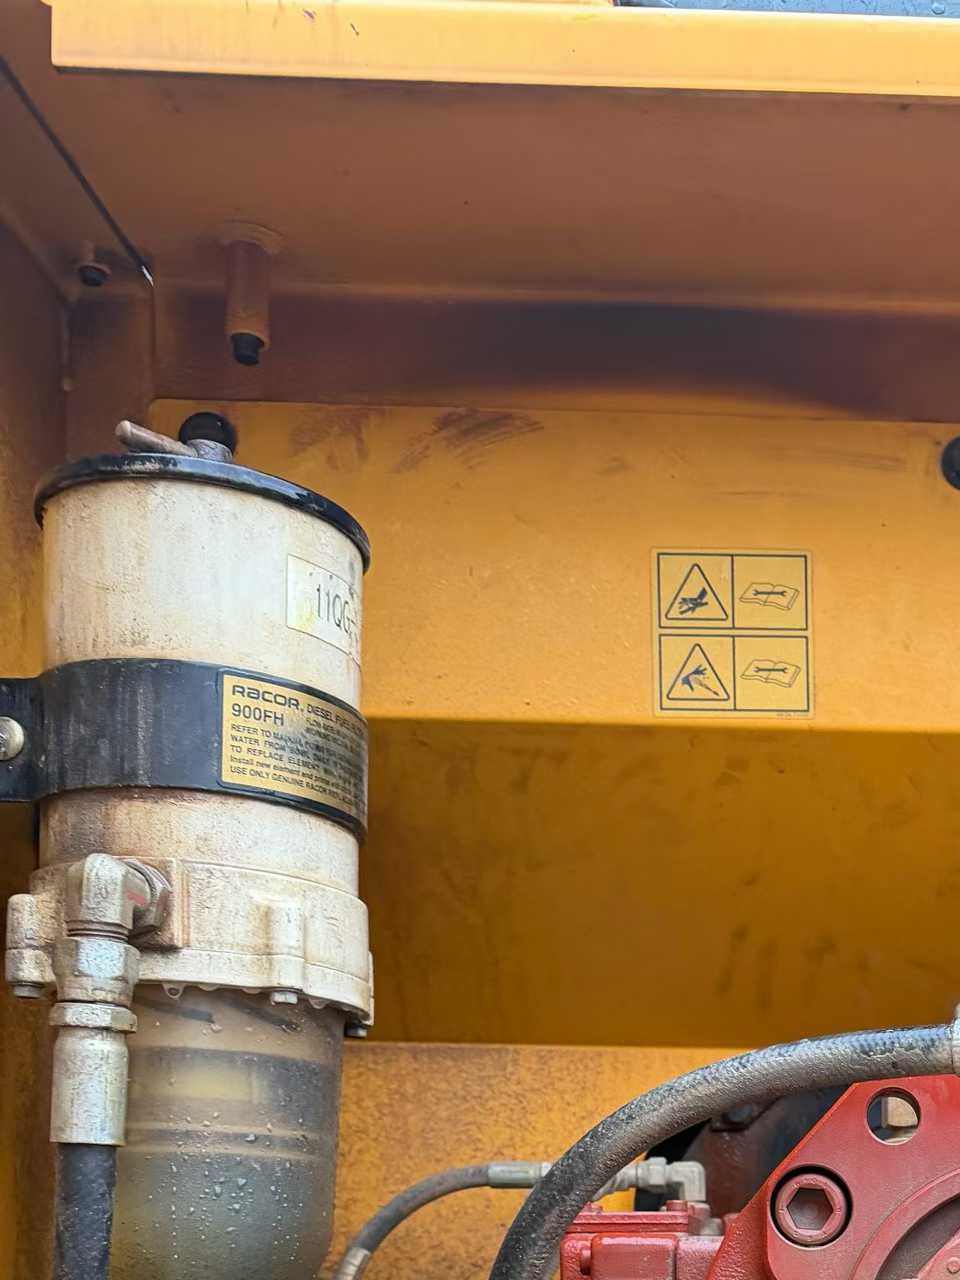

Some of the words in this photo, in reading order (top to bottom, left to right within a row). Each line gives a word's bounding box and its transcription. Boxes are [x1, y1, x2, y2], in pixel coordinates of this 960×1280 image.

[231, 703, 285, 727] 900FH
[231, 723, 259, 737] REFER
[231, 734, 260, 747] WATER
[231, 744, 242, 753] TO
[246, 747, 284, 762] REPLACE
[230, 765, 247, 775] USE
[249, 768, 270, 779] ONLY
